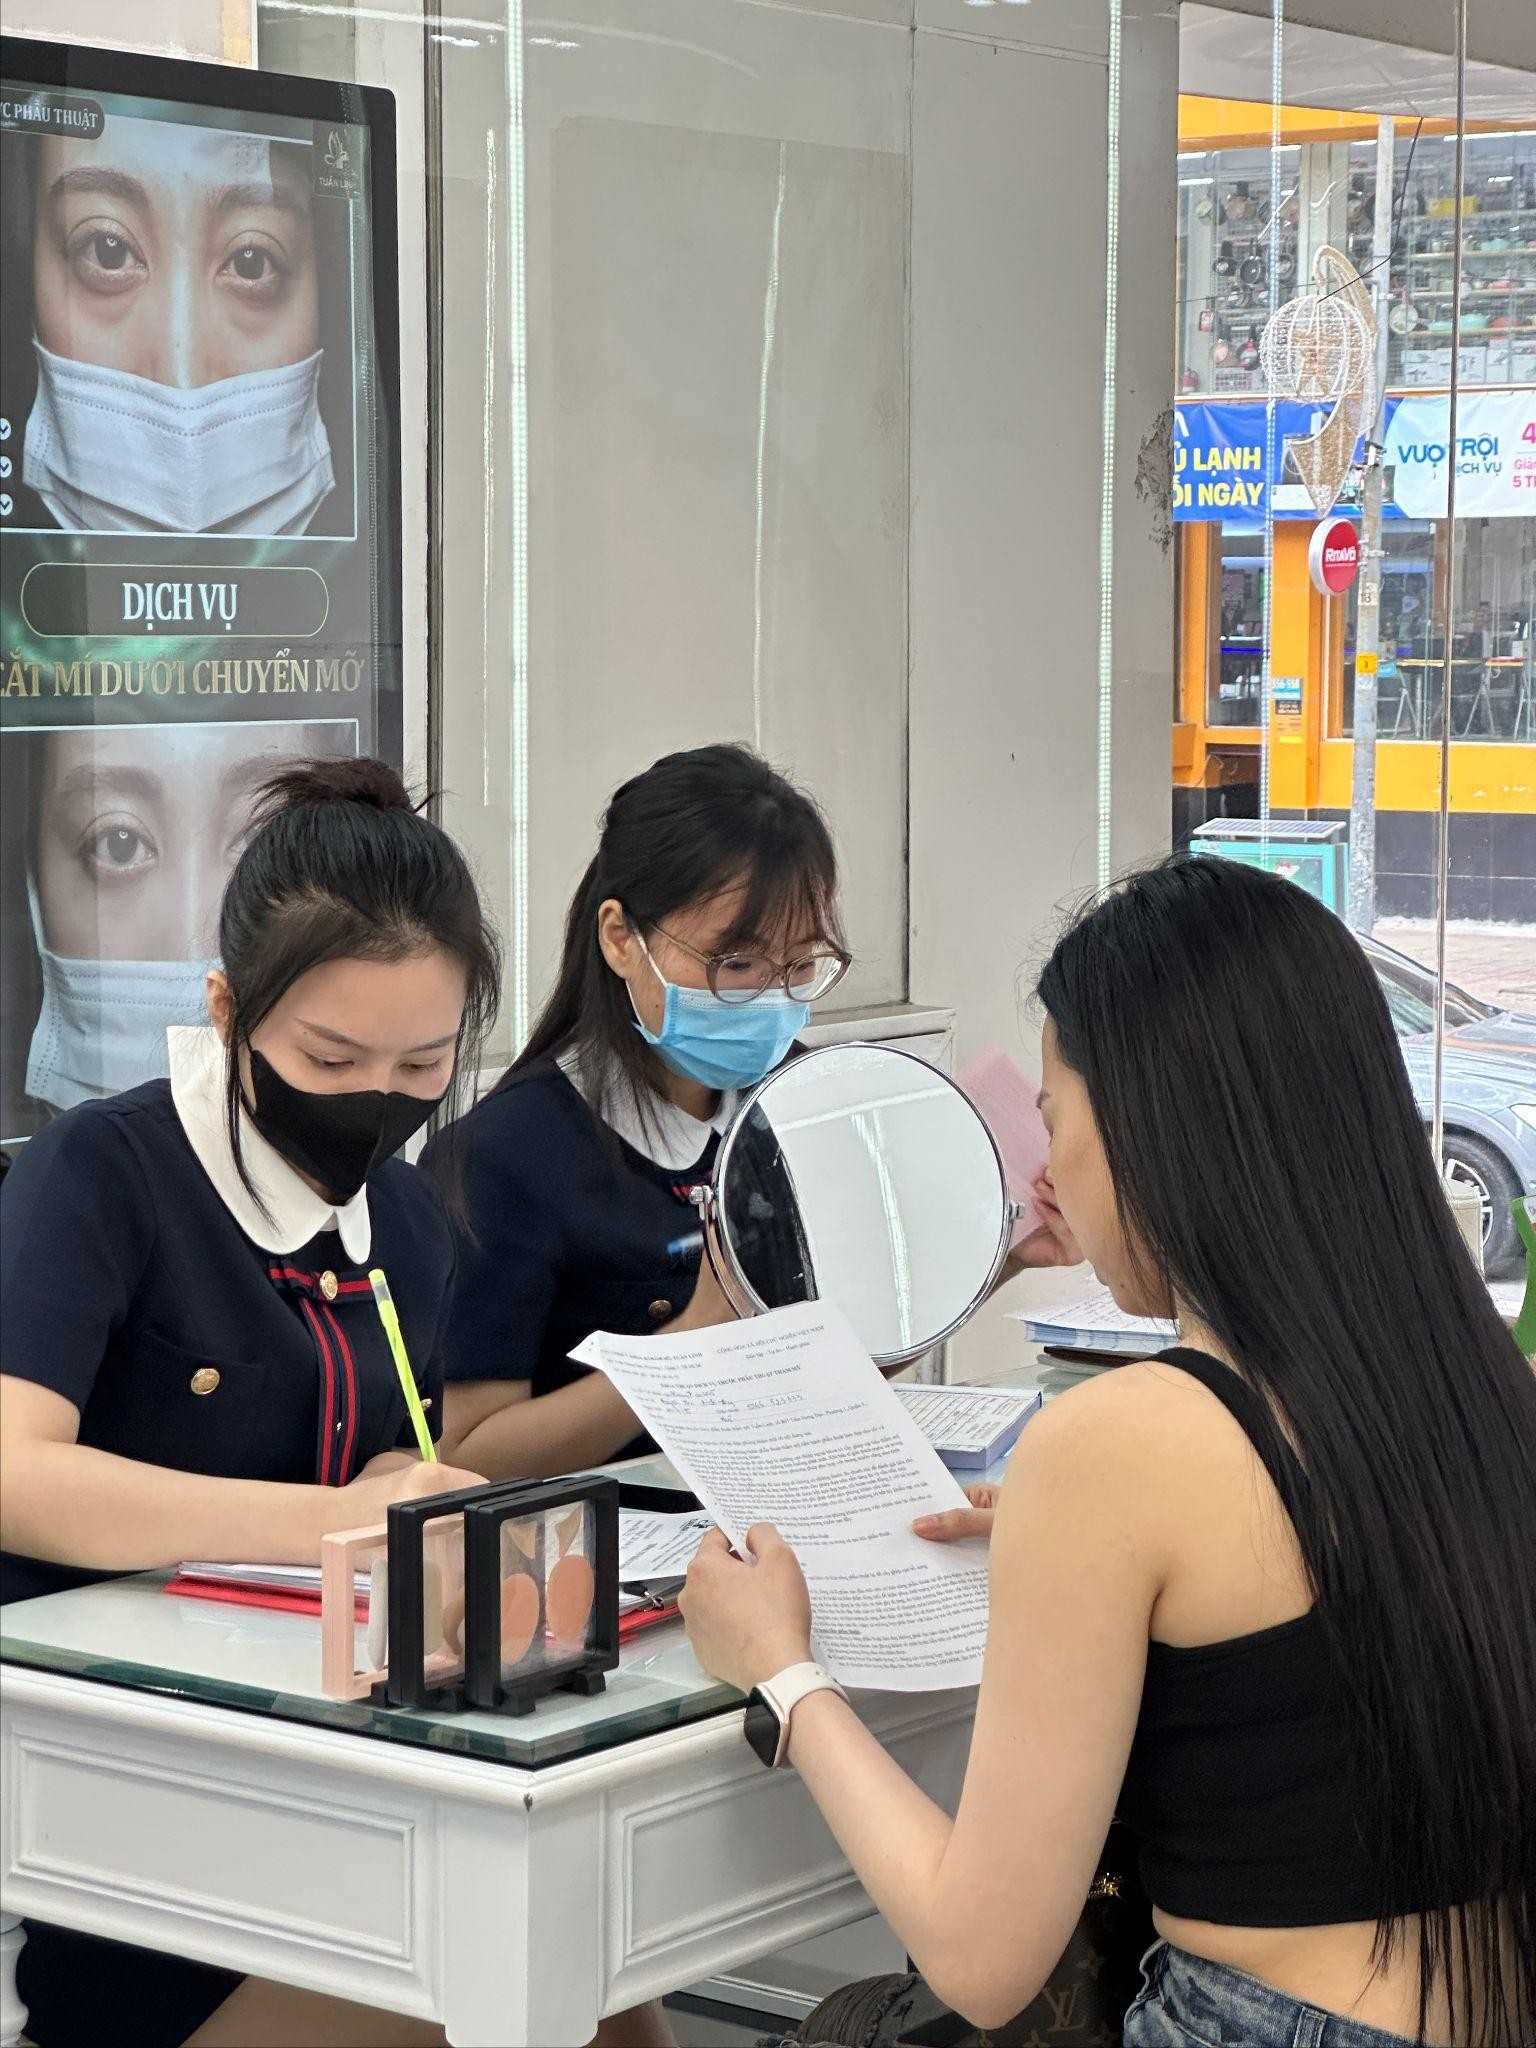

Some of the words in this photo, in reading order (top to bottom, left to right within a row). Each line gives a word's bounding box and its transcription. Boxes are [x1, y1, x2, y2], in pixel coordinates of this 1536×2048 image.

[14, 99, 51, 122] PHẪU
[53, 107, 98, 131] THUẬT
[1193, 446, 1261, 477] LẠNH
[1197, 476, 1265, 507] NGÀY
[1513, 475, 1522, 488] 5
[123, 582, 194, 631] DỊCH
[198, 583, 238, 631] VỤ
[54, 654, 92, 697] MÍ
[193, 648, 310, 694] CHUYỂN
[315, 649, 365, 693] MỠ
